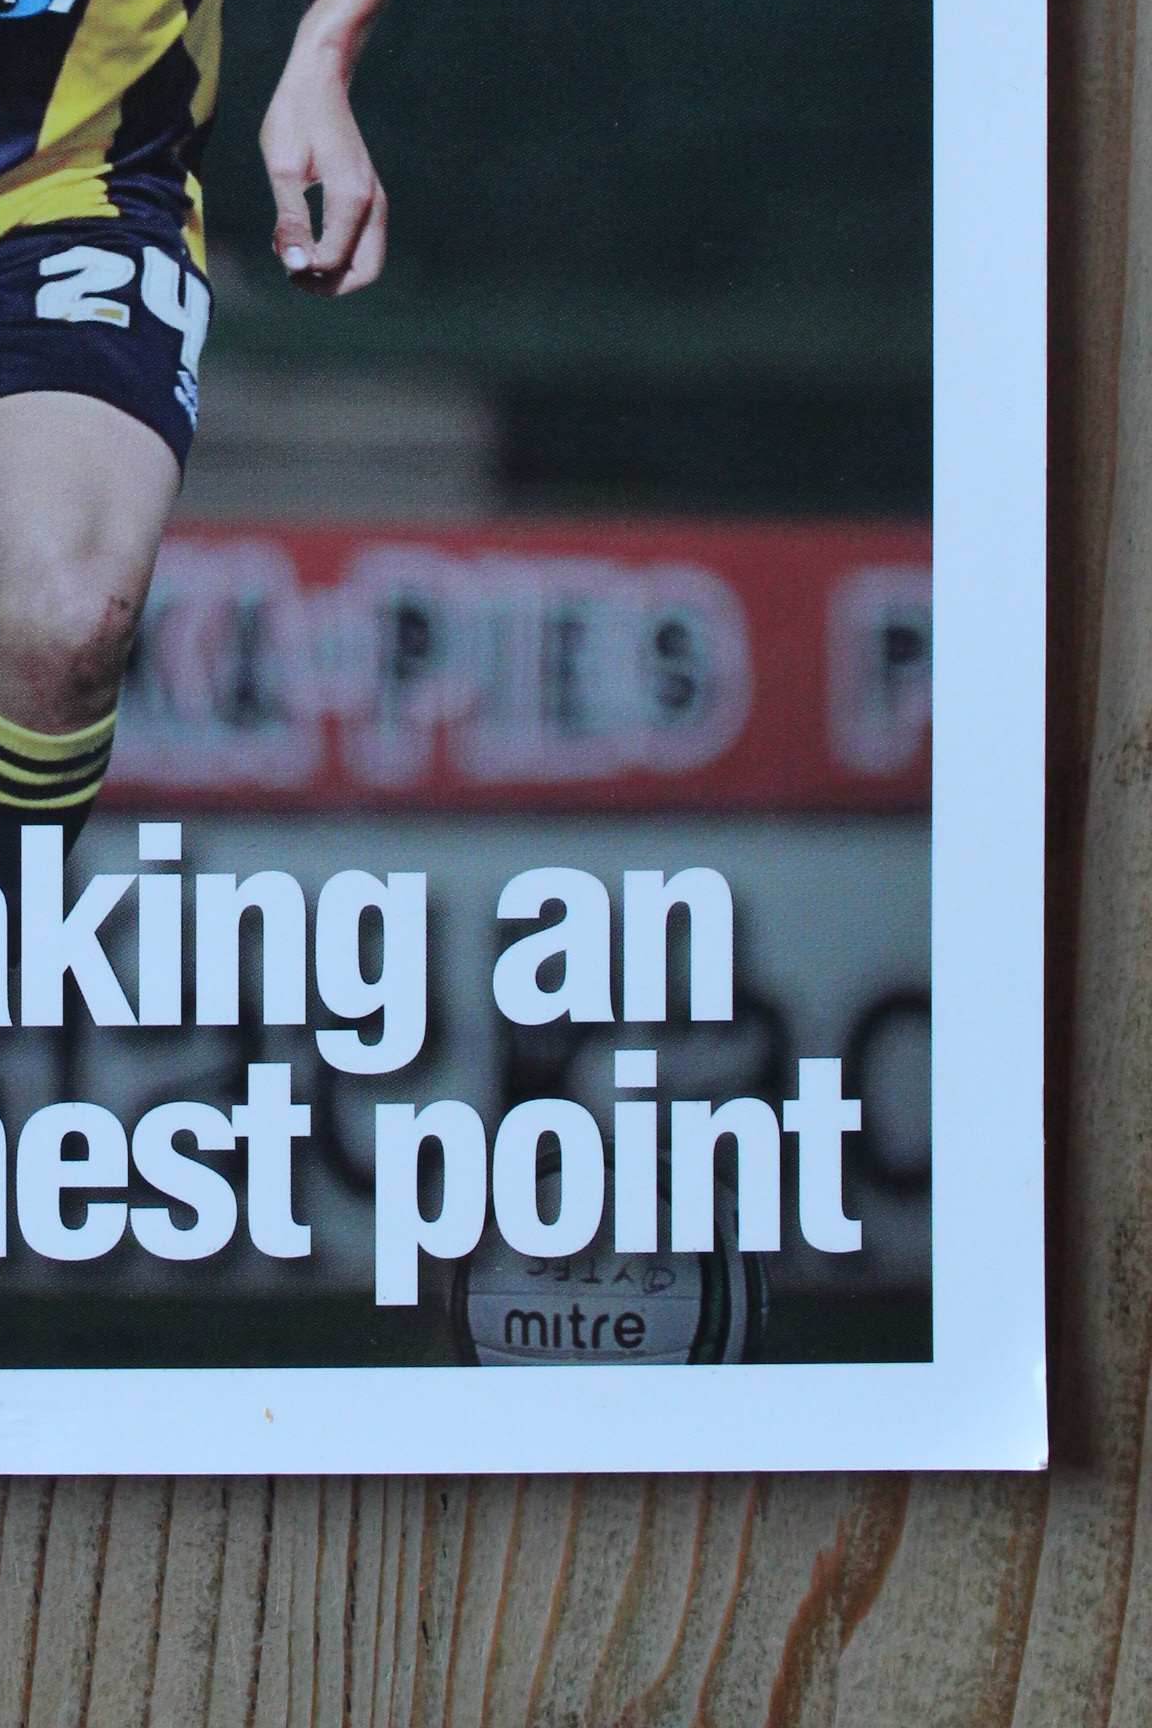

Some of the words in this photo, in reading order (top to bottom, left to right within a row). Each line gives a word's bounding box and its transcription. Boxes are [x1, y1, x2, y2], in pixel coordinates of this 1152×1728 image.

[35, 245, 211, 383] 24
[491, 866, 734, 1027] an
[374, 1049, 863, 1306] point
[504, 1303, 646, 1350] mitre
